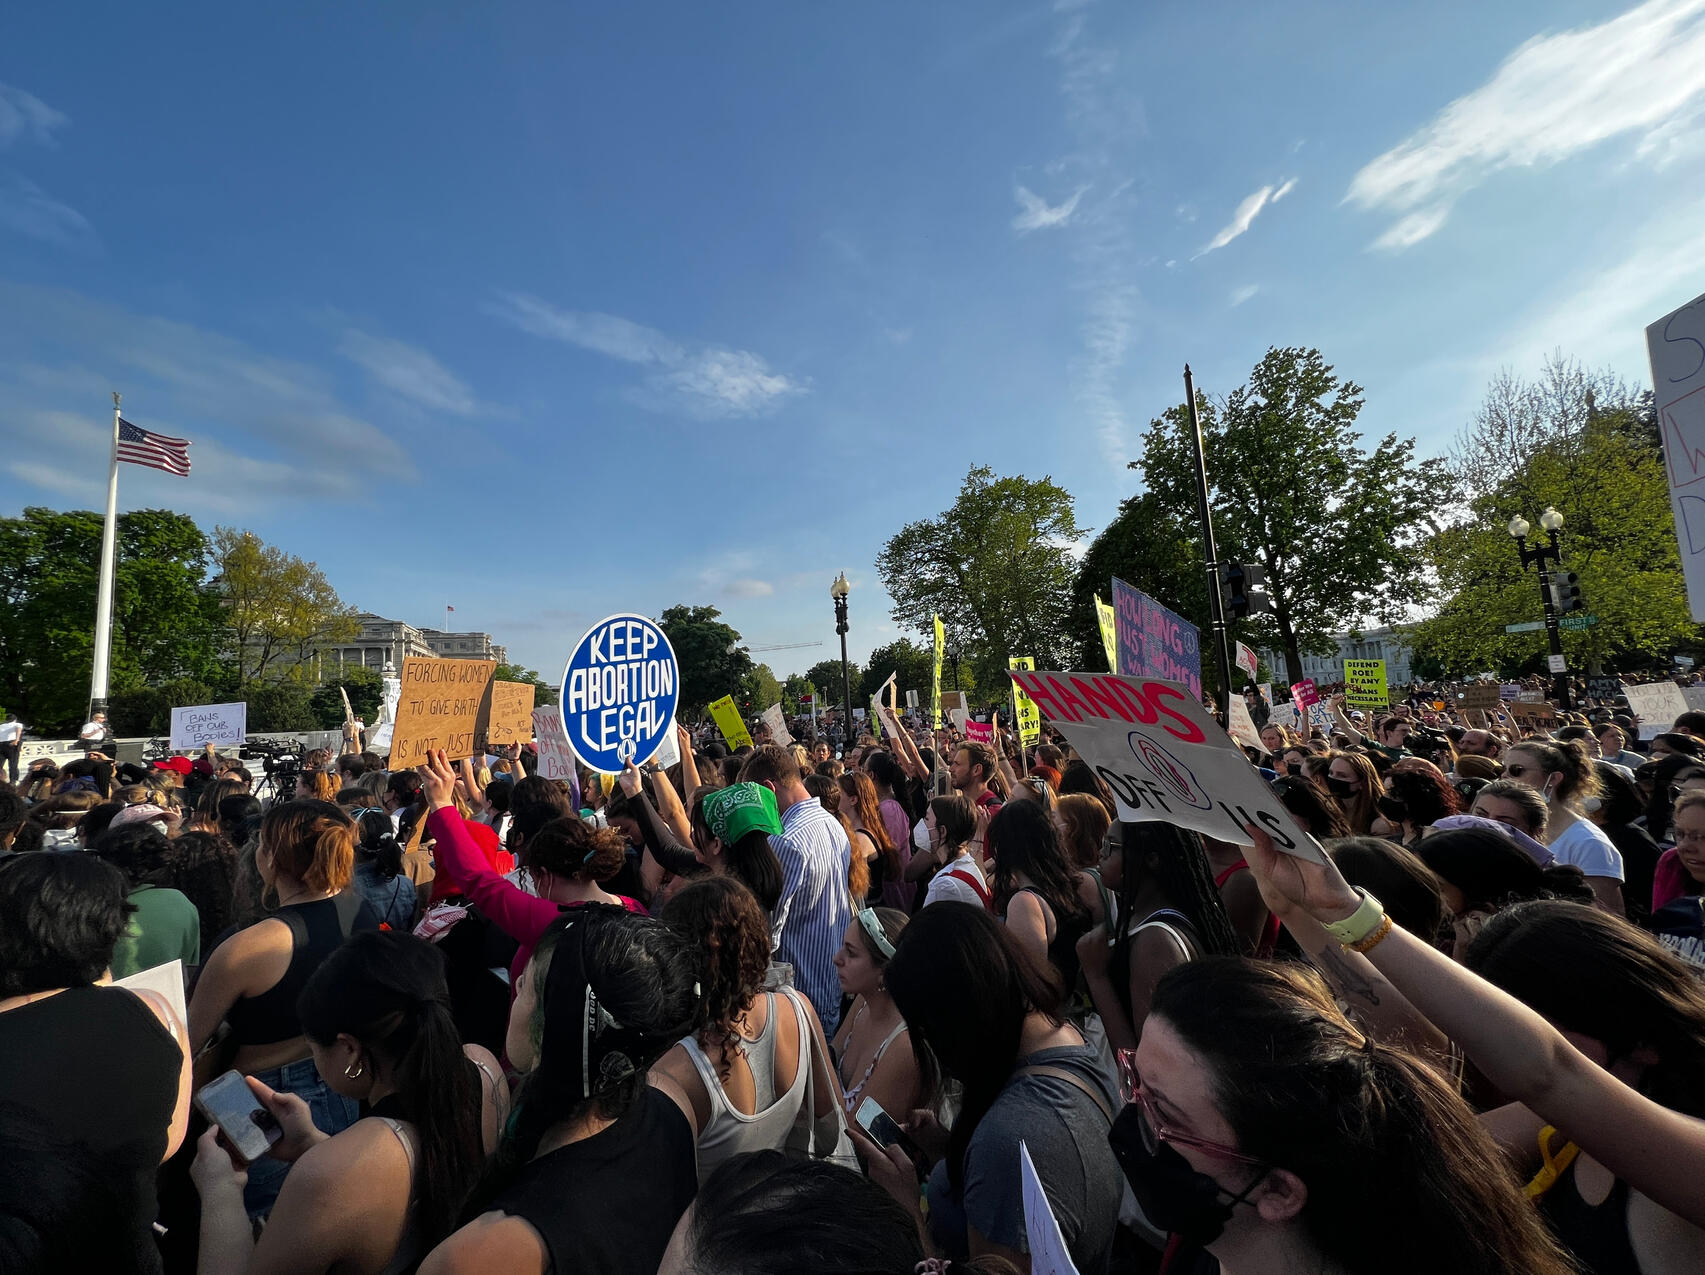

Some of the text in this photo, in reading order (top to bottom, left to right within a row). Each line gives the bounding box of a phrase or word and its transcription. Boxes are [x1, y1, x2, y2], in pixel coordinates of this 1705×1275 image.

[1115, 587, 1143, 627] HOW
[1560, 618, 1587, 626] FIRST
[590, 621, 659, 665] KEEP
[406, 662, 494, 684] FORCING WOMEN
[1589, 679, 1618, 687] AMY
[569, 658, 674, 714] ABORTION
[189, 712, 219, 724] BANS
[410, 700, 424, 715] TO
[430, 699, 451, 715] GIVE
[453, 698, 480, 716] BIRTH
[1011, 673, 1207, 744] HANDS
[185, 721, 229, 733] OFF OUR
[581, 700, 666, 753] LEGAL
[397, 739, 408, 760] IS
[414, 737, 438, 757] NOT
[1095, 765, 1297, 850] OFF US
